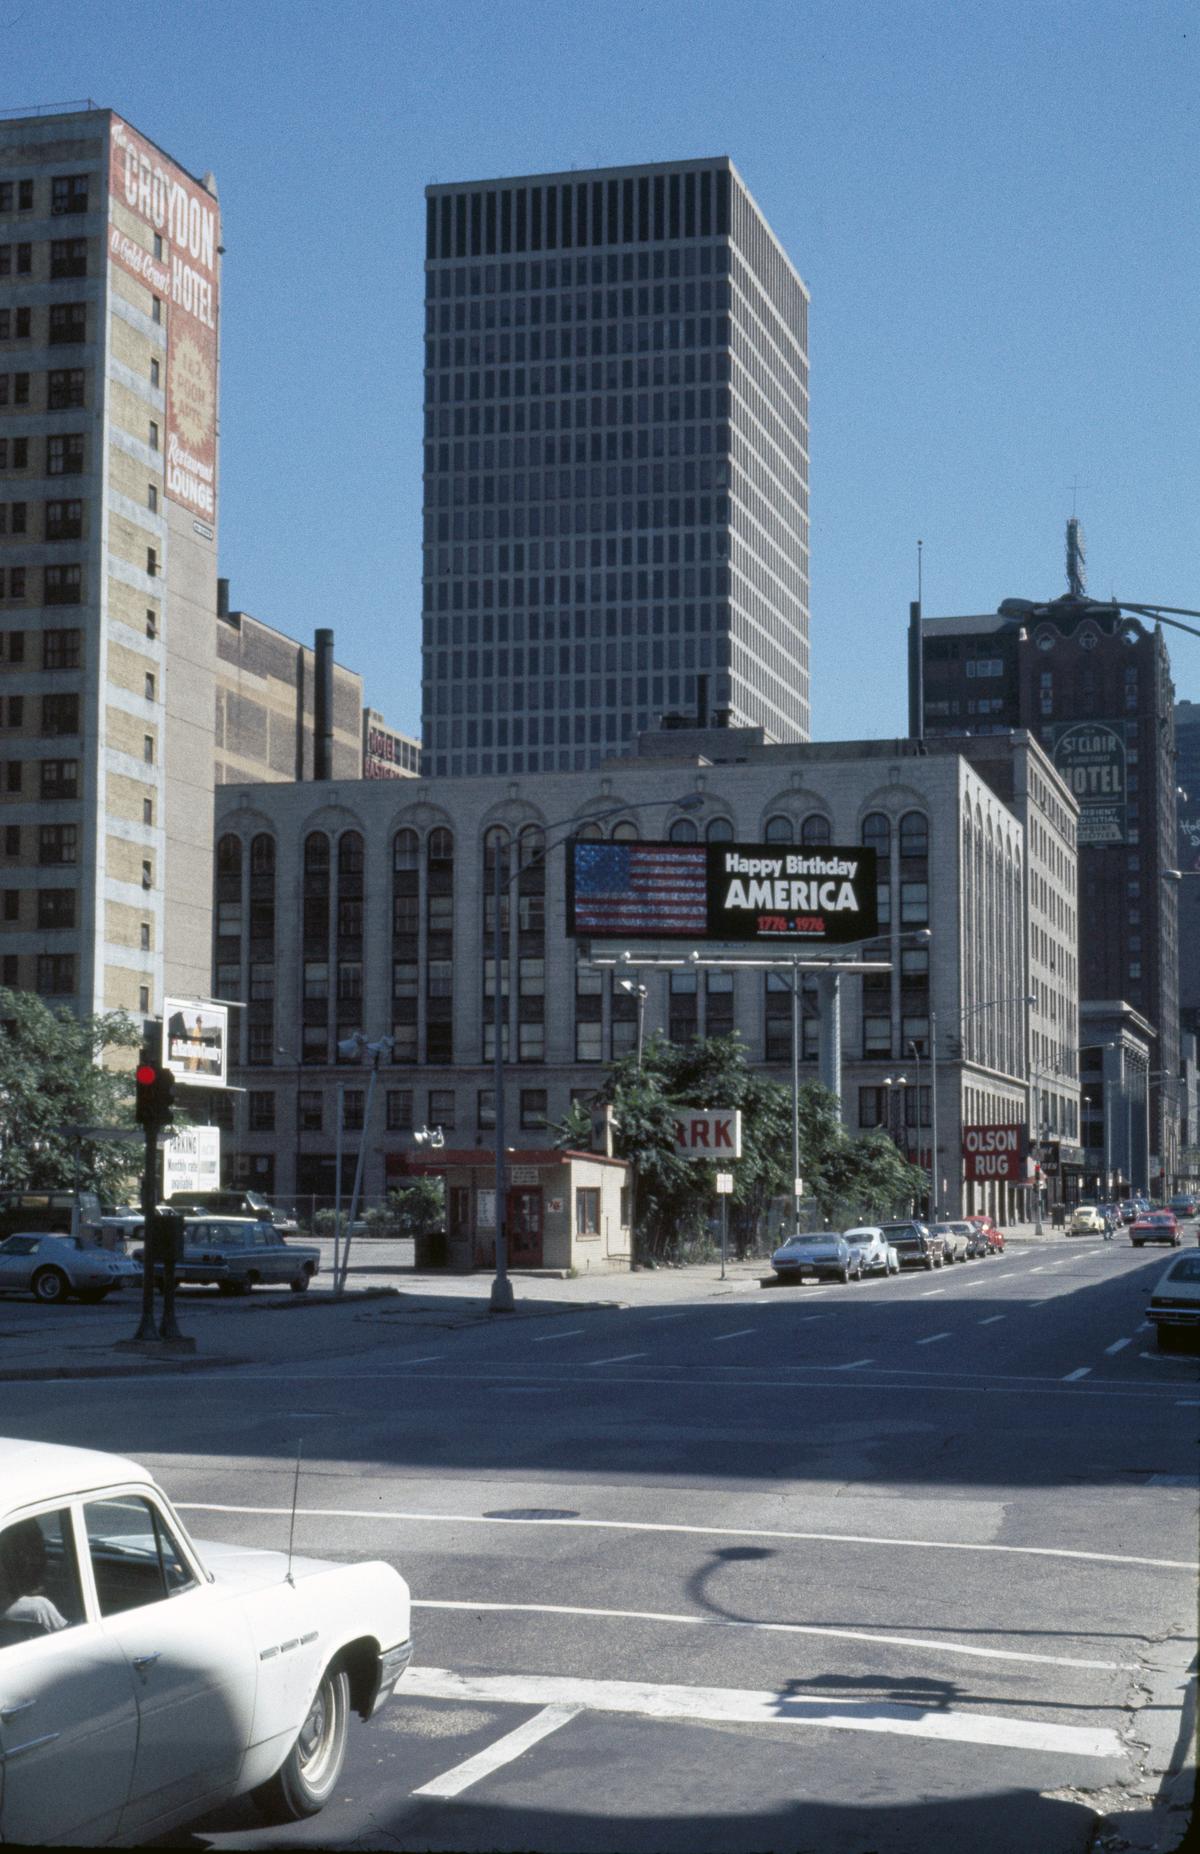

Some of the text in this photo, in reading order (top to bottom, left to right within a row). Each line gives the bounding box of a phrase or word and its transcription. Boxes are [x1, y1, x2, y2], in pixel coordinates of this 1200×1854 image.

[125, 144, 214, 271] CROYDON
[172, 256, 215, 329] HOTEL
[167, 464, 213, 513] LOUNGE
[1059, 765, 1122, 794] HOTEL
[725, 851, 859, 880] Happy Birthday
[723, 878, 860, 912] AMERICA
[757, 915, 826, 932] 1776 1976
[168, 1134, 198, 1154] PARKING
[672, 1118, 735, 1148] ARK
[966, 1130, 1017, 1152] OLSON
[974, 1155, 1009, 1175] RUG
